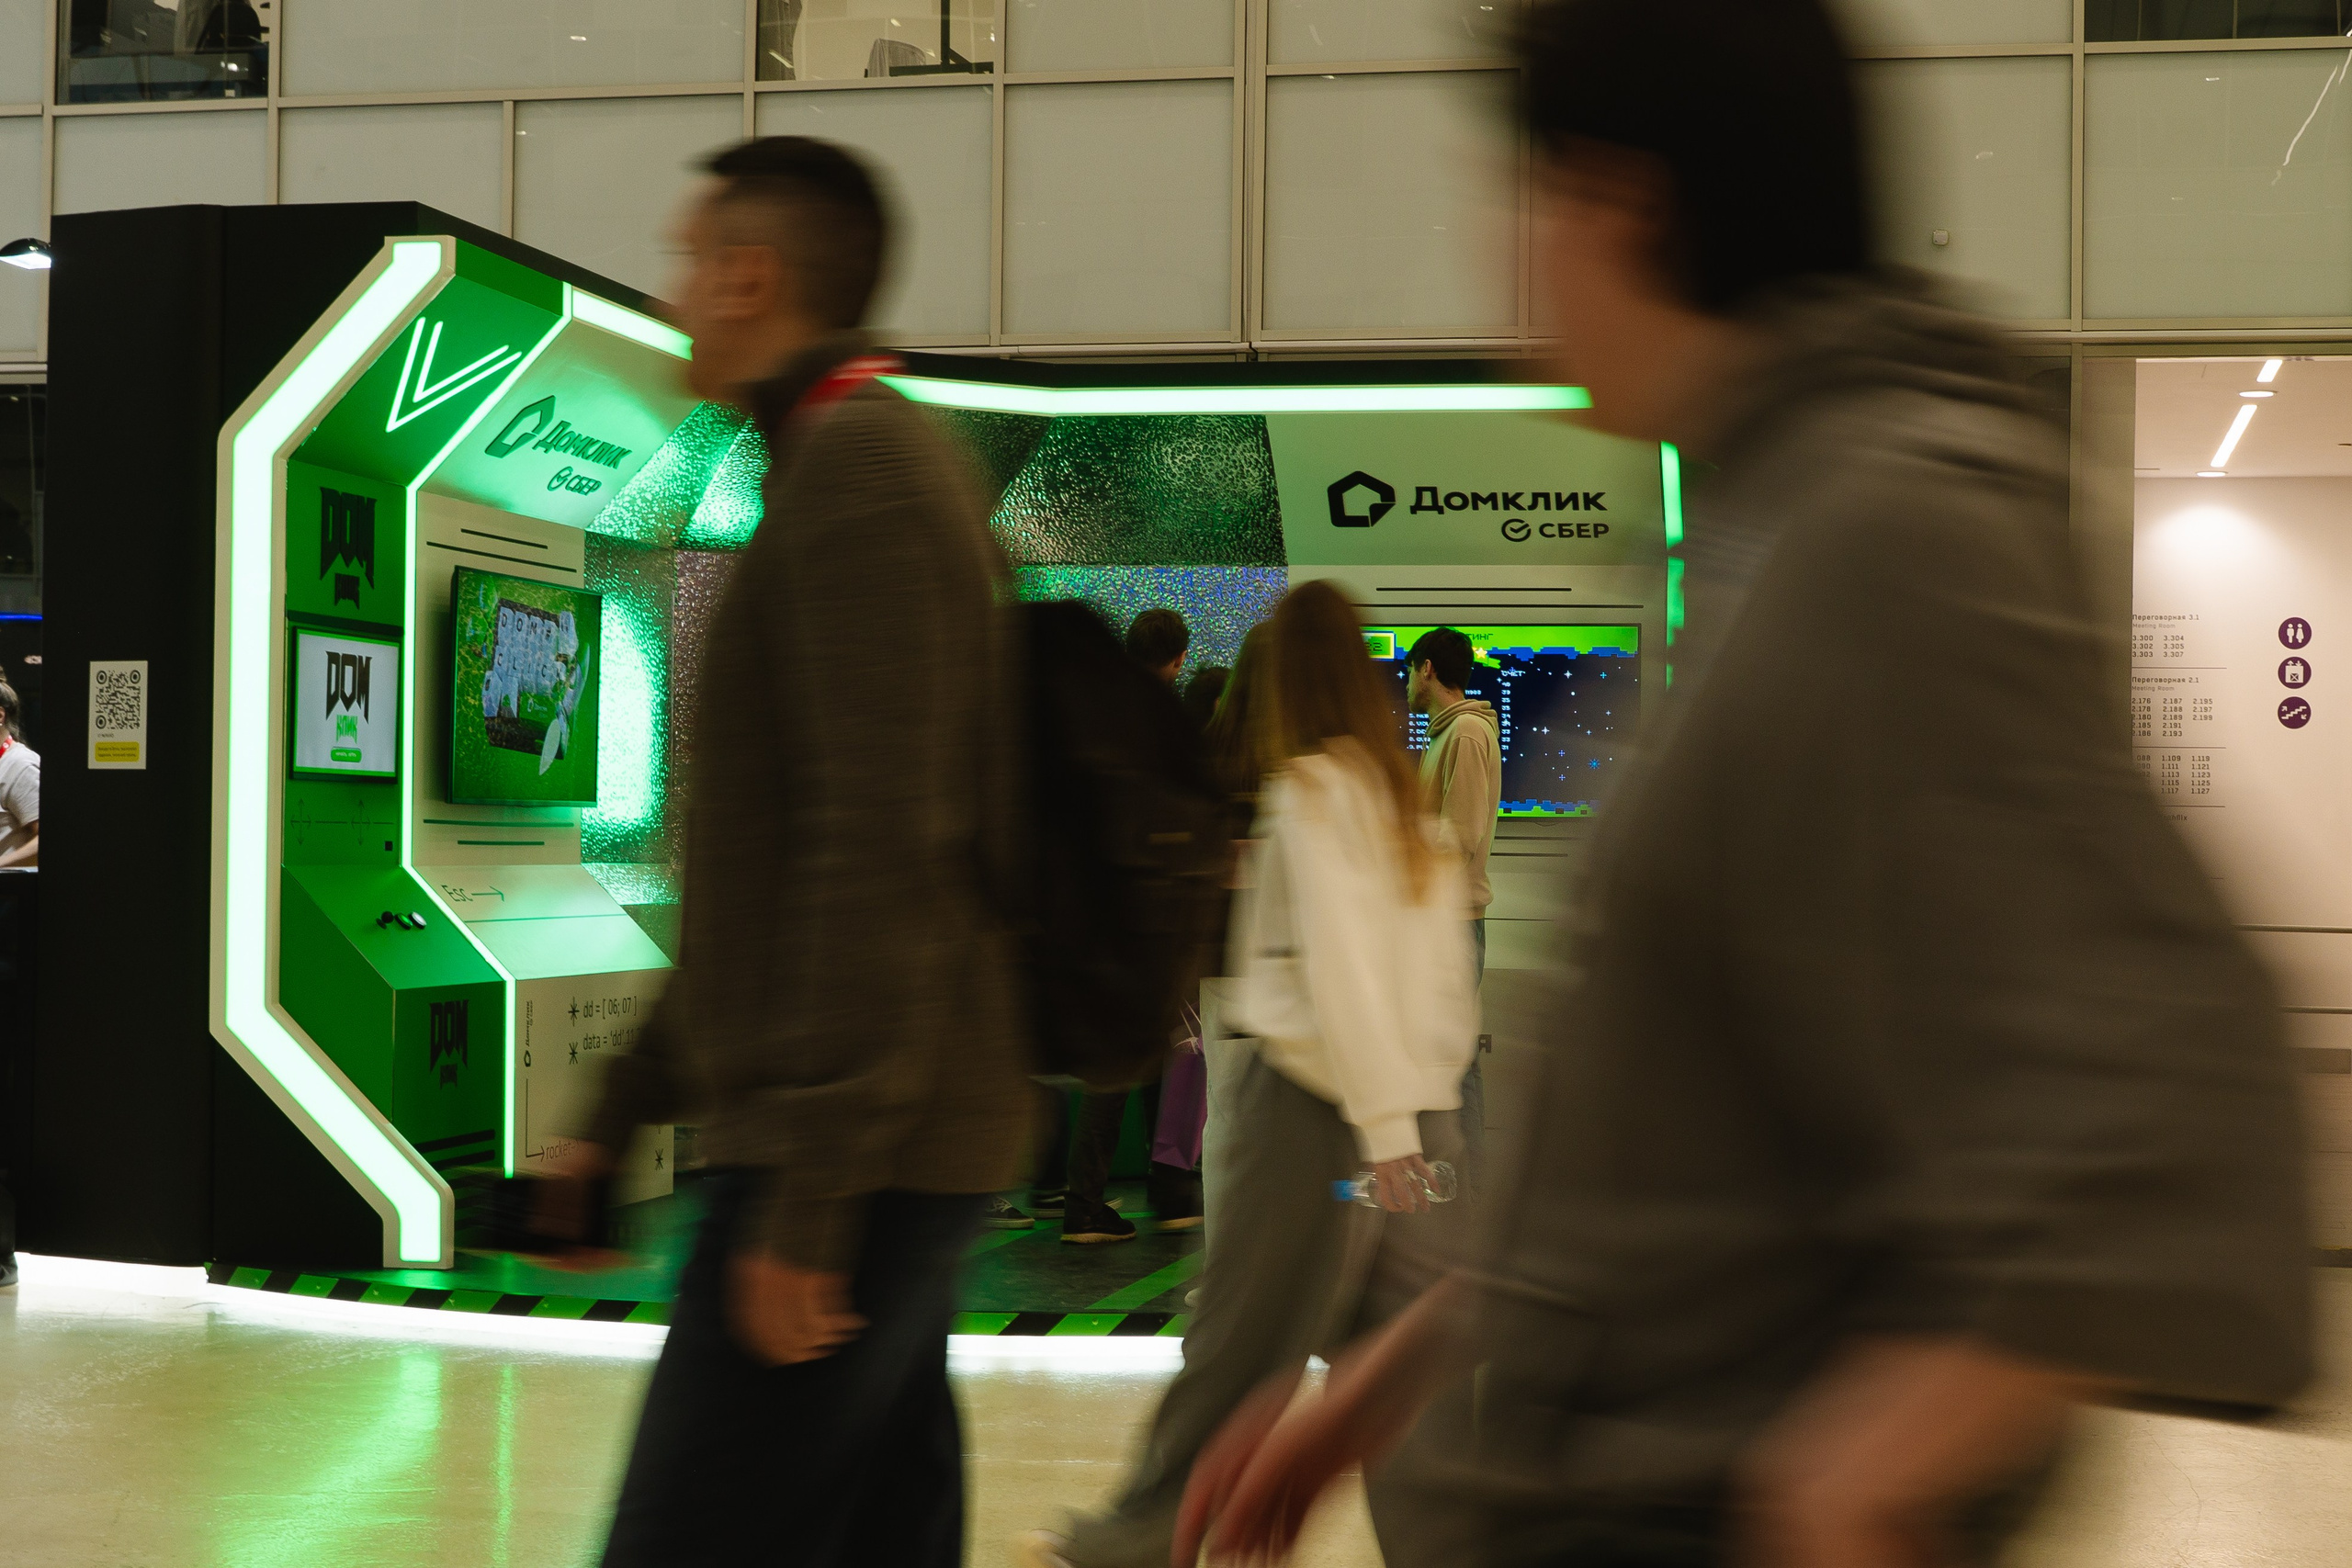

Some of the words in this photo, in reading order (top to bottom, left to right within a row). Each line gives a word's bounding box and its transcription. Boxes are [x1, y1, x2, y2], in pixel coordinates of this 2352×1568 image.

[531, 420, 633, 469] Домклик
[565, 474, 602, 496] СБЕР
[1409, 486, 1609, 514] Домклик
[1538, 523, 1610, 538] СБЕР
[2132, 614, 2187, 622] Переговорная
[325, 650, 373, 725] DOM
[2132, 676, 2187, 684] Переговорная
[440, 884, 474, 902] Esc
[582, 1000, 594, 1019] dd
[622, 997, 632, 1014] 07
[582, 1032, 601, 1051] data
[546, 1139, 571, 1160] rocket
